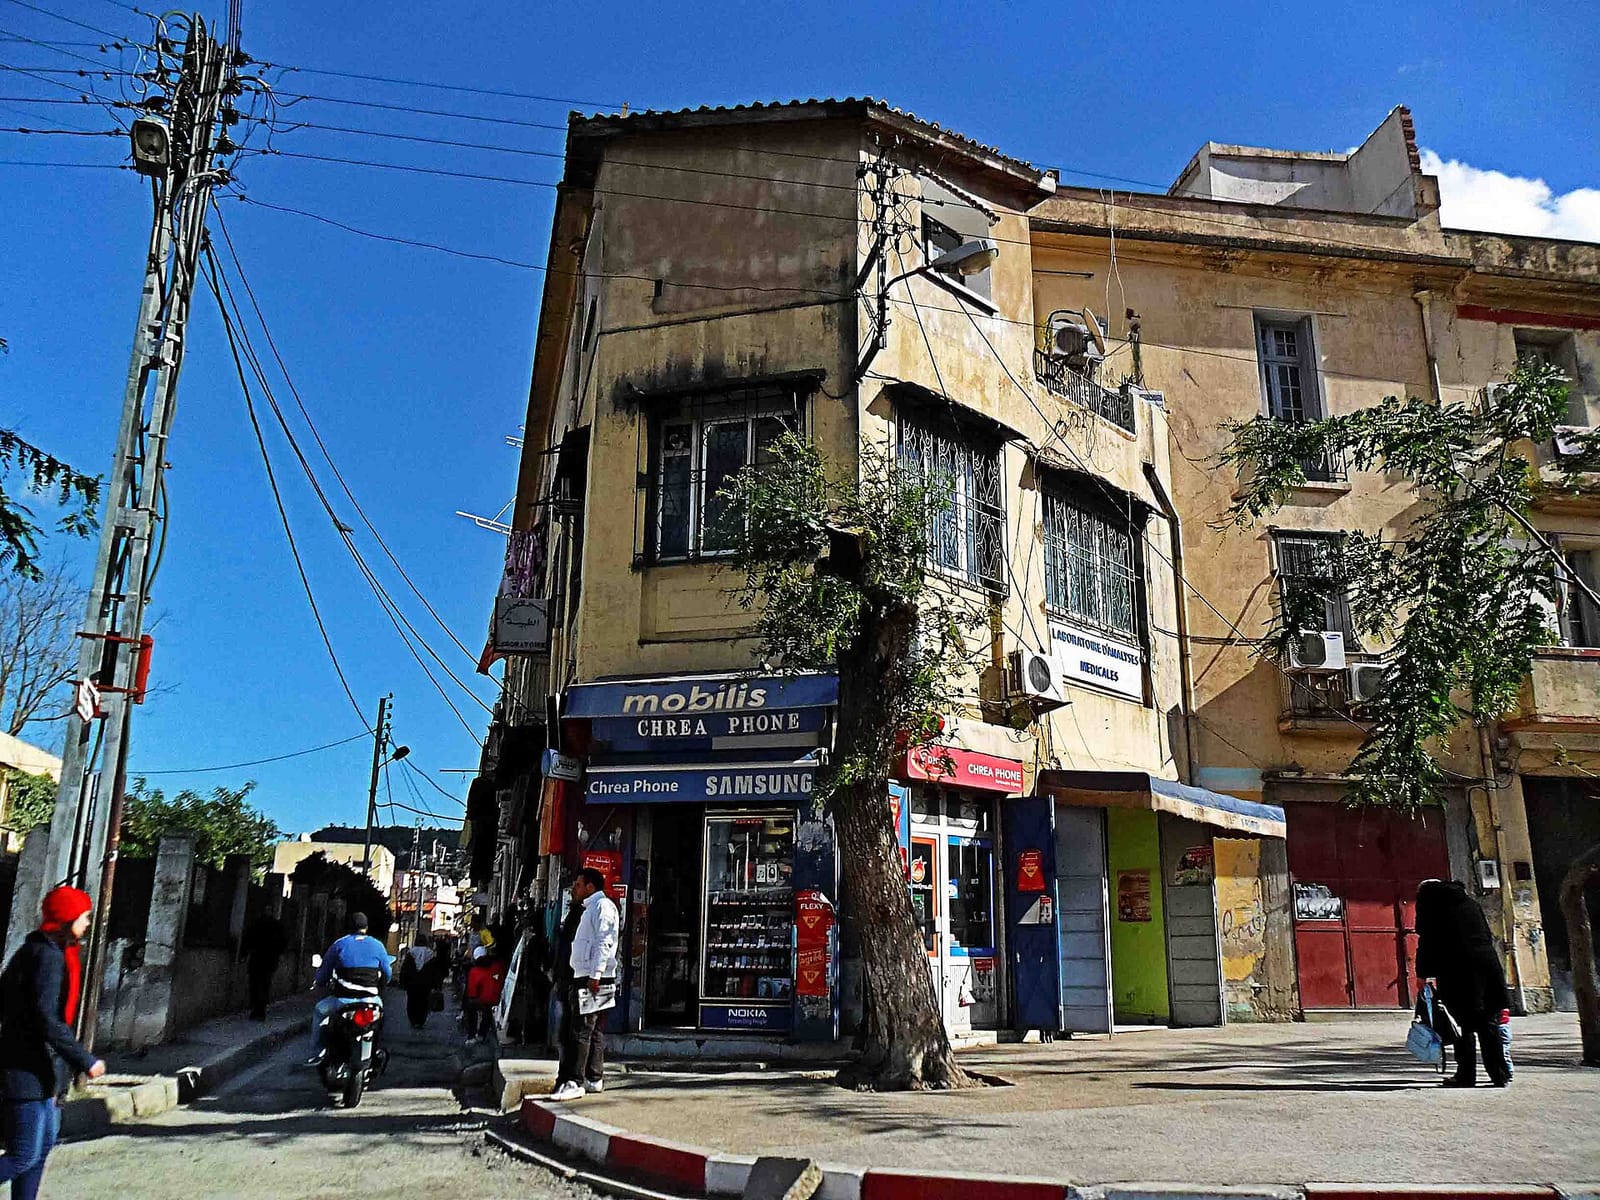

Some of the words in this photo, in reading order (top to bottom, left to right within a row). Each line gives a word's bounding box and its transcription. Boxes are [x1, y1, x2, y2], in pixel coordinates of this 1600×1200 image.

[1052, 628, 1102, 653] LABORATOIRE
[1080, 660, 1119, 682] MEDICALES
[623, 683, 767, 713] mobilis
[637, 719, 708, 737] CHREA
[728, 712, 800, 734] PHONE
[968, 763, 994, 777] CHREA
[995, 767, 1021, 781] PHONE
[589, 781, 630, 794] Chrea
[633, 780, 679, 793] Phone
[705, 773, 813, 796] SAMSUNG
[728, 1008, 767, 1017] NOKIA
